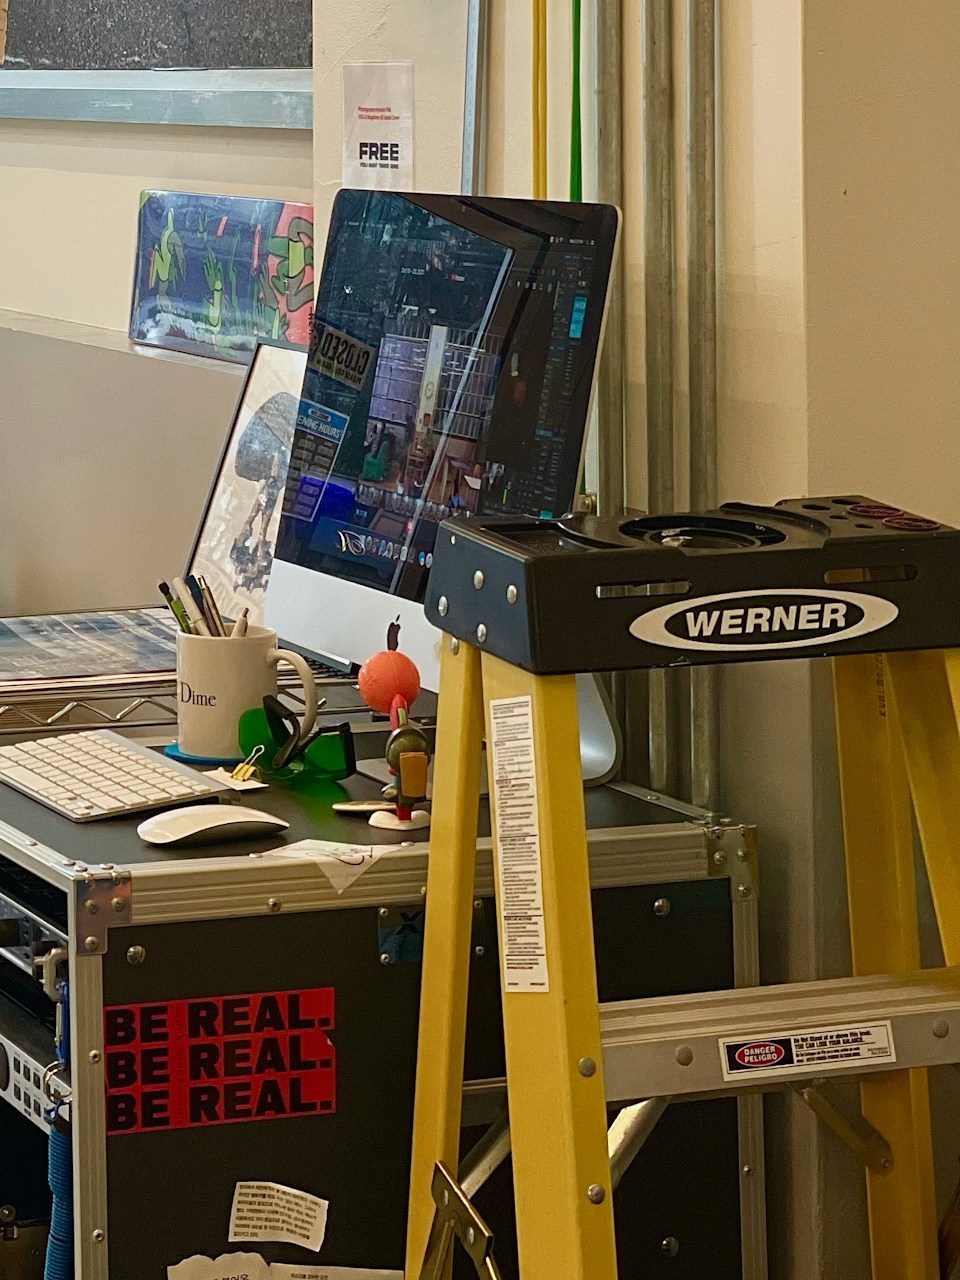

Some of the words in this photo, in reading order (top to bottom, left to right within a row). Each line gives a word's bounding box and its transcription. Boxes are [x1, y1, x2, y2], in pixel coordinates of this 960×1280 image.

[359, 142, 399, 161] FREE
[319, 421, 341, 438] HOURS
[685, 603, 847, 637] WERNER
[181, 681, 217, 707] Dime
[105, 1005, 169, 1046] BE
[189, 994, 331, 1039] REAL.
[107, 1047, 170, 1089] BE
[190, 1035, 332, 1081] REAL.
[744, 1046, 775, 1055] DANGER
[744, 1053, 778, 1063] PELIGRO
[107, 1090, 170, 1131] BE
[190, 1077, 332, 1123] REAL.
